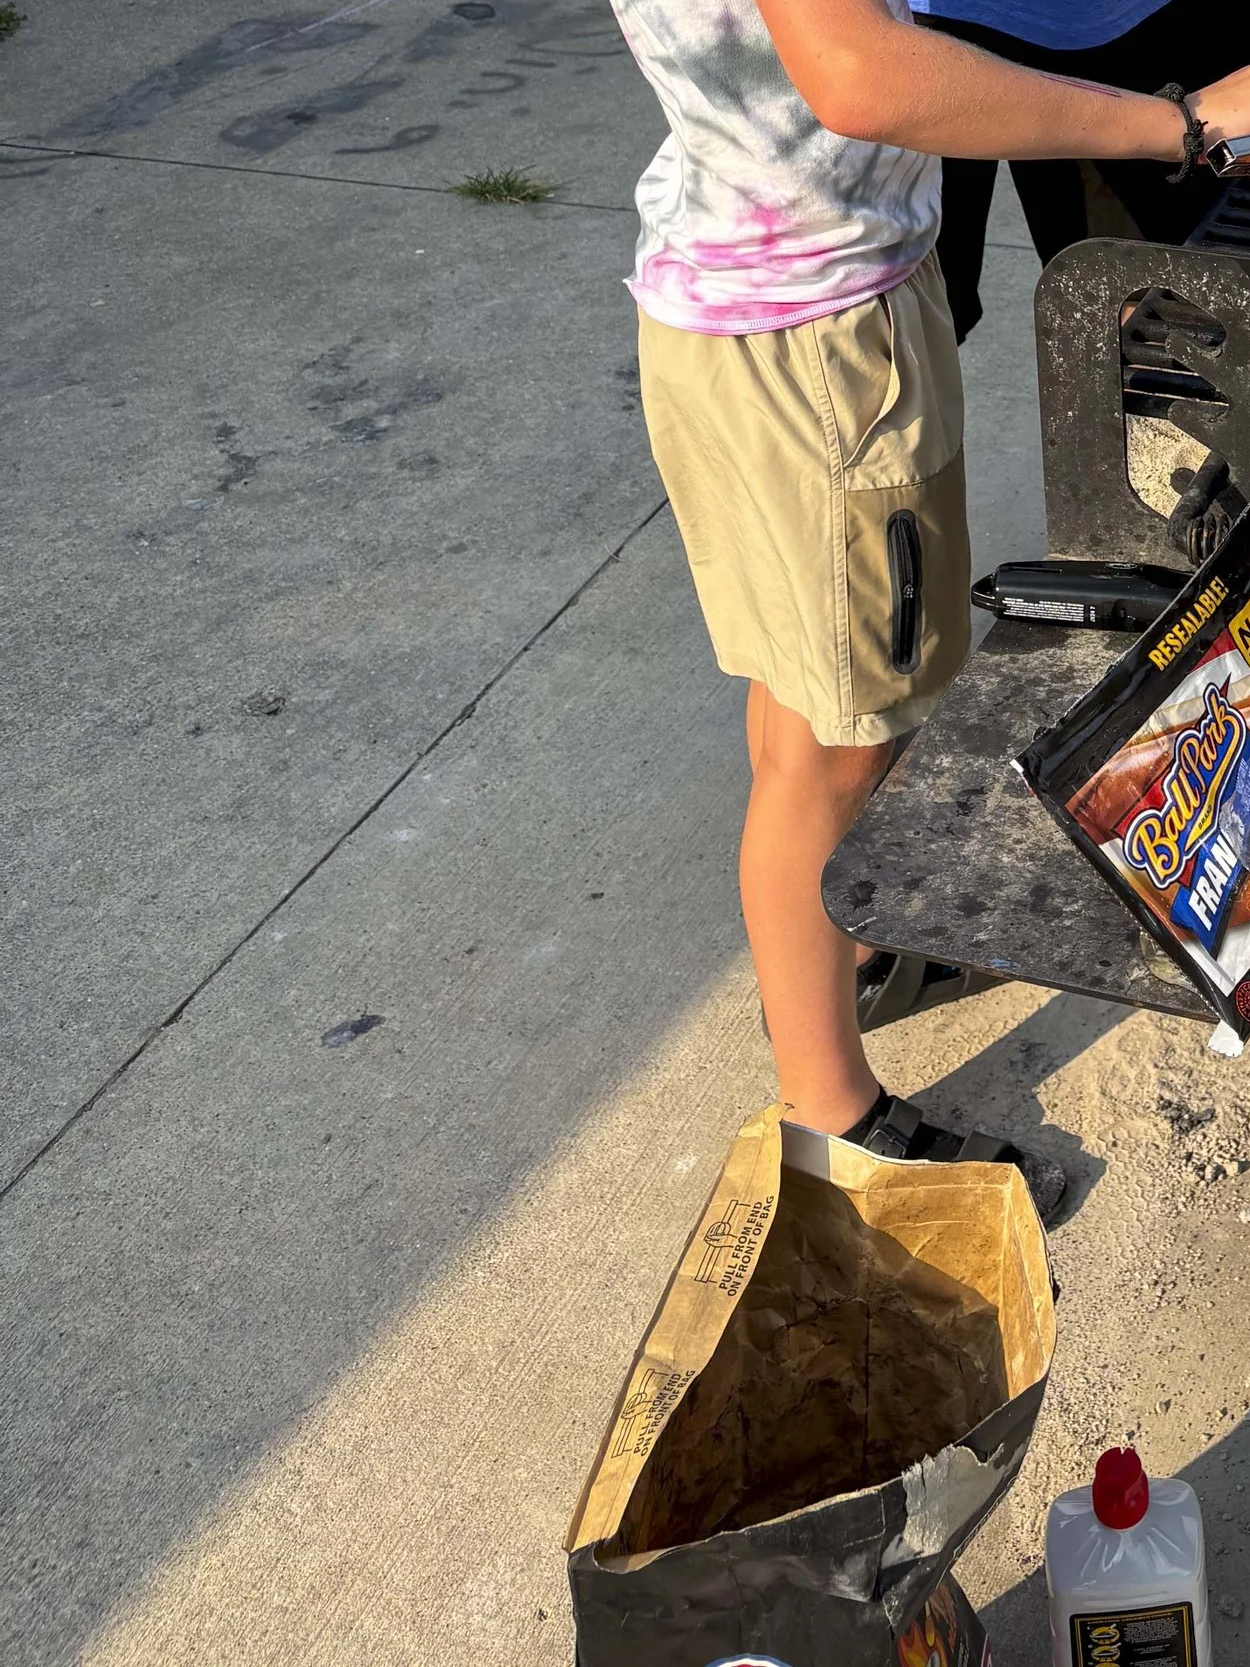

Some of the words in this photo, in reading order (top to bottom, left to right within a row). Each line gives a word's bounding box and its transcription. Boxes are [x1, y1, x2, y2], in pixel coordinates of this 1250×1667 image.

[1148, 576, 1230, 671] RESEALABLE!
[1198, 804, 1213, 830] BRAND
[1188, 824, 1239, 931] FRAN
[719, 1263, 738, 1289] PULL
[732, 1226, 752, 1259] FROM
[747, 1201, 763, 1224] END
[727, 1281, 740, 1297] ON
[735, 1239, 757, 1279] FRONT
[752, 1221, 764, 1236] OF
[759, 1195, 775, 1219] BAG
[633, 1423, 651, 1454] PULL
[645, 1392, 668, 1420] FROM
[663, 1373, 681, 1392] END
[641, 1436, 653, 1456] ON
[648, 1401, 672, 1433] FRONT
[668, 1389, 681, 1401] OF
[679, 1370, 696, 1389] BAG
